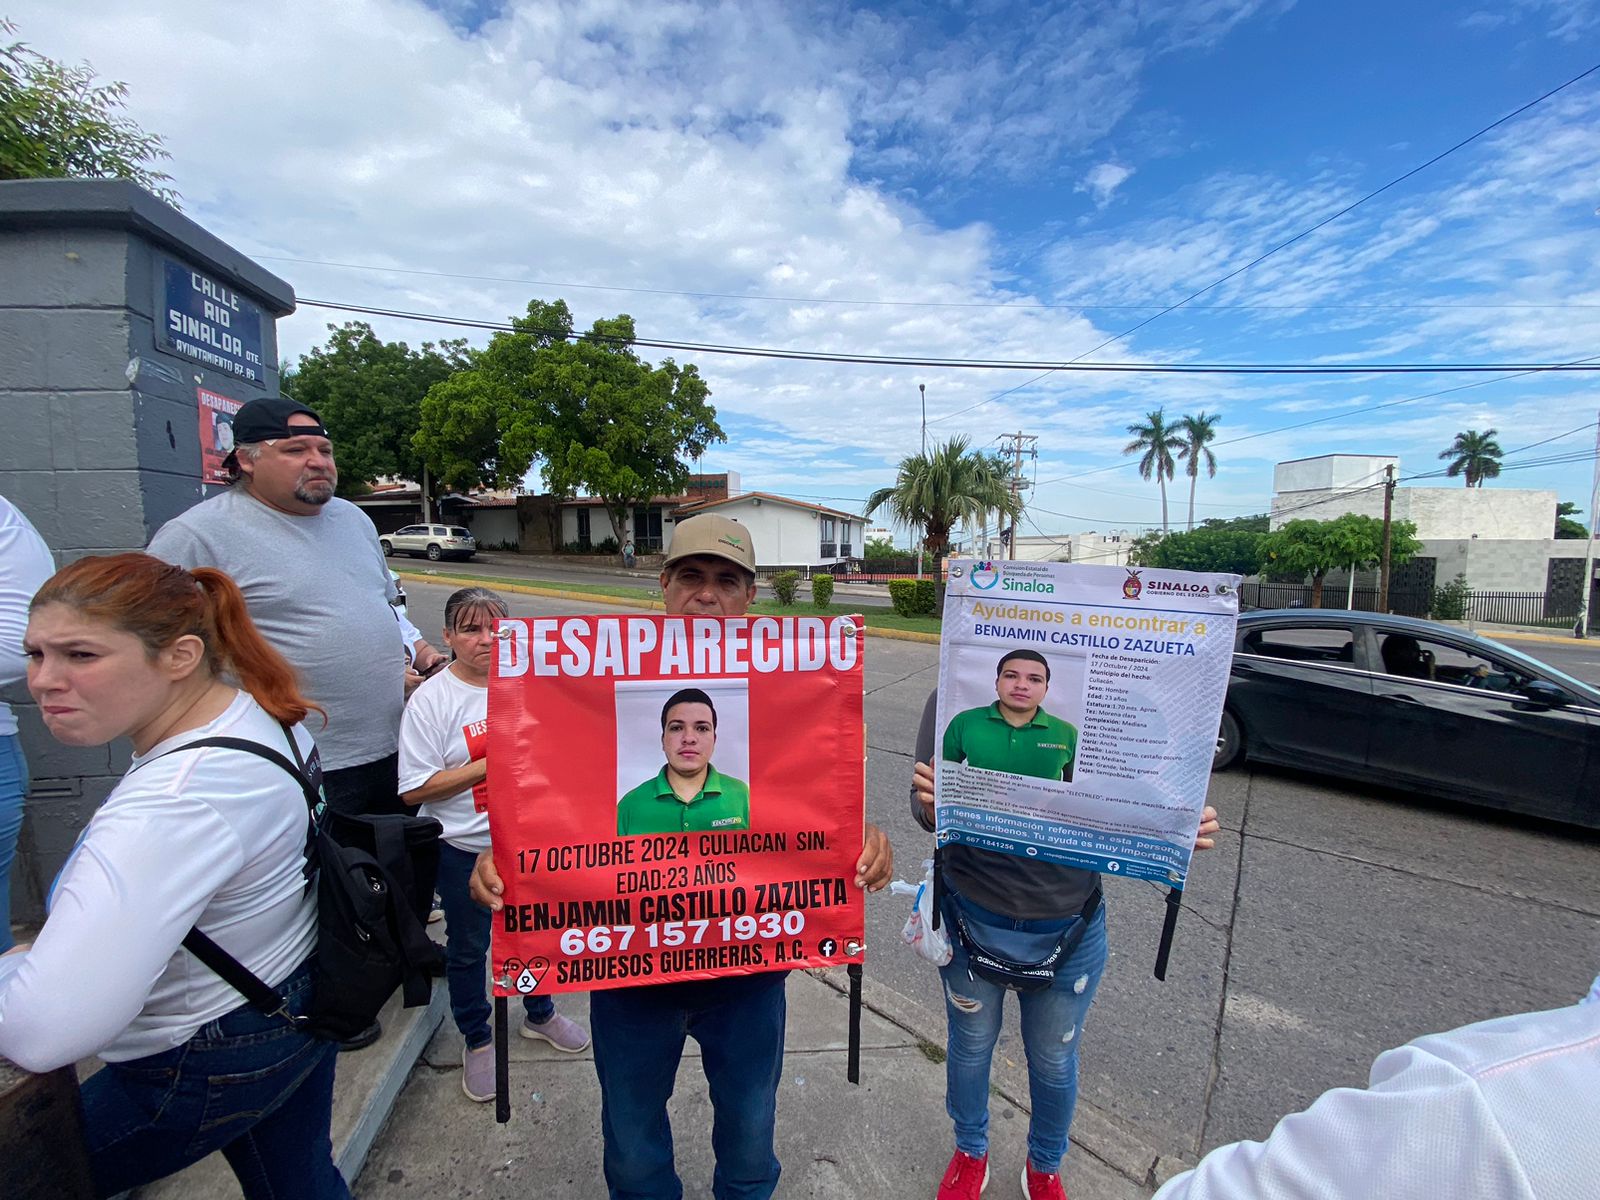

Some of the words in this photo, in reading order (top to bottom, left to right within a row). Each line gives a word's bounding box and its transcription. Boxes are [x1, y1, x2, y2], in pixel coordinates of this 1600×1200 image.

[192, 272, 239, 312] CALLE
[204, 300, 230, 328] RIO
[169, 309, 242, 357] SINALOA
[245, 350, 262, 366] OTE.
[176, 340, 233, 372] AYUNTAMIENTO
[1002, 577, 1055, 594] Sinaloa
[1147, 581, 1210, 593] SINALOA
[972, 602, 1064, 624] Ayúdanos
[1071, 612, 1082, 625] a
[1088, 613, 1188, 634] encontrar
[1194, 622, 1207, 636] a
[498, 616, 857, 677] DESAPARECIDO
[975, 623, 1047, 642] BENJAMIN
[1050, 631, 1120, 649] CASTILLO
[1123, 638, 1196, 657] ZAZUETA
[1091, 652, 1109, 661] Fecha
[1103, 662, 1128, 671] Octubre
[1090, 669, 1120, 678] Municipio
[1120, 671, 1131, 679] del
[1104, 687, 1129, 695] Hombre
[1098, 710, 1121, 718] Morena
[1121, 719, 1148, 728] Mediana
[1099, 740, 1118, 748] Ancha
[1101, 755, 1127, 764] Mediana
[940, 808, 949, 817] Si
[953, 808, 981, 820] tienes
[985, 813, 1044, 832] información
[1048, 826, 1094, 840] referente
[1109, 834, 1132, 846] esta
[1136, 840, 1183, 860] persona,
[965, 836, 979, 844] 667
[966, 819, 973, 828] o
[1033, 831, 1045, 841] Tu
[1047, 836, 1078, 848] ayuda
[1080, 839, 1093, 848] es
[1095, 841, 1119, 853] muy
[517, 848, 541, 874] 17
[546, 840, 635, 872] OCTUBRE
[641, 836, 690, 862] 2024
[699, 832, 787, 857] CULIACAN
[796, 831, 830, 851] SIN.
[616, 866, 688, 895] EDAD:23
[693, 860, 736, 887] AÑOS
[504, 898, 631, 933] BENJAMIN
[640, 886, 747, 924] CASTILLO
[754, 877, 848, 914] ZAZUETA
[560, 925, 636, 956] 667
[644, 919, 710, 949] 157
[717, 910, 805, 942] 1930
[556, 953, 654, 985] SABUESOS
[660, 943, 769, 974] GUERRERAS,
[774, 939, 809, 963] A.C.
